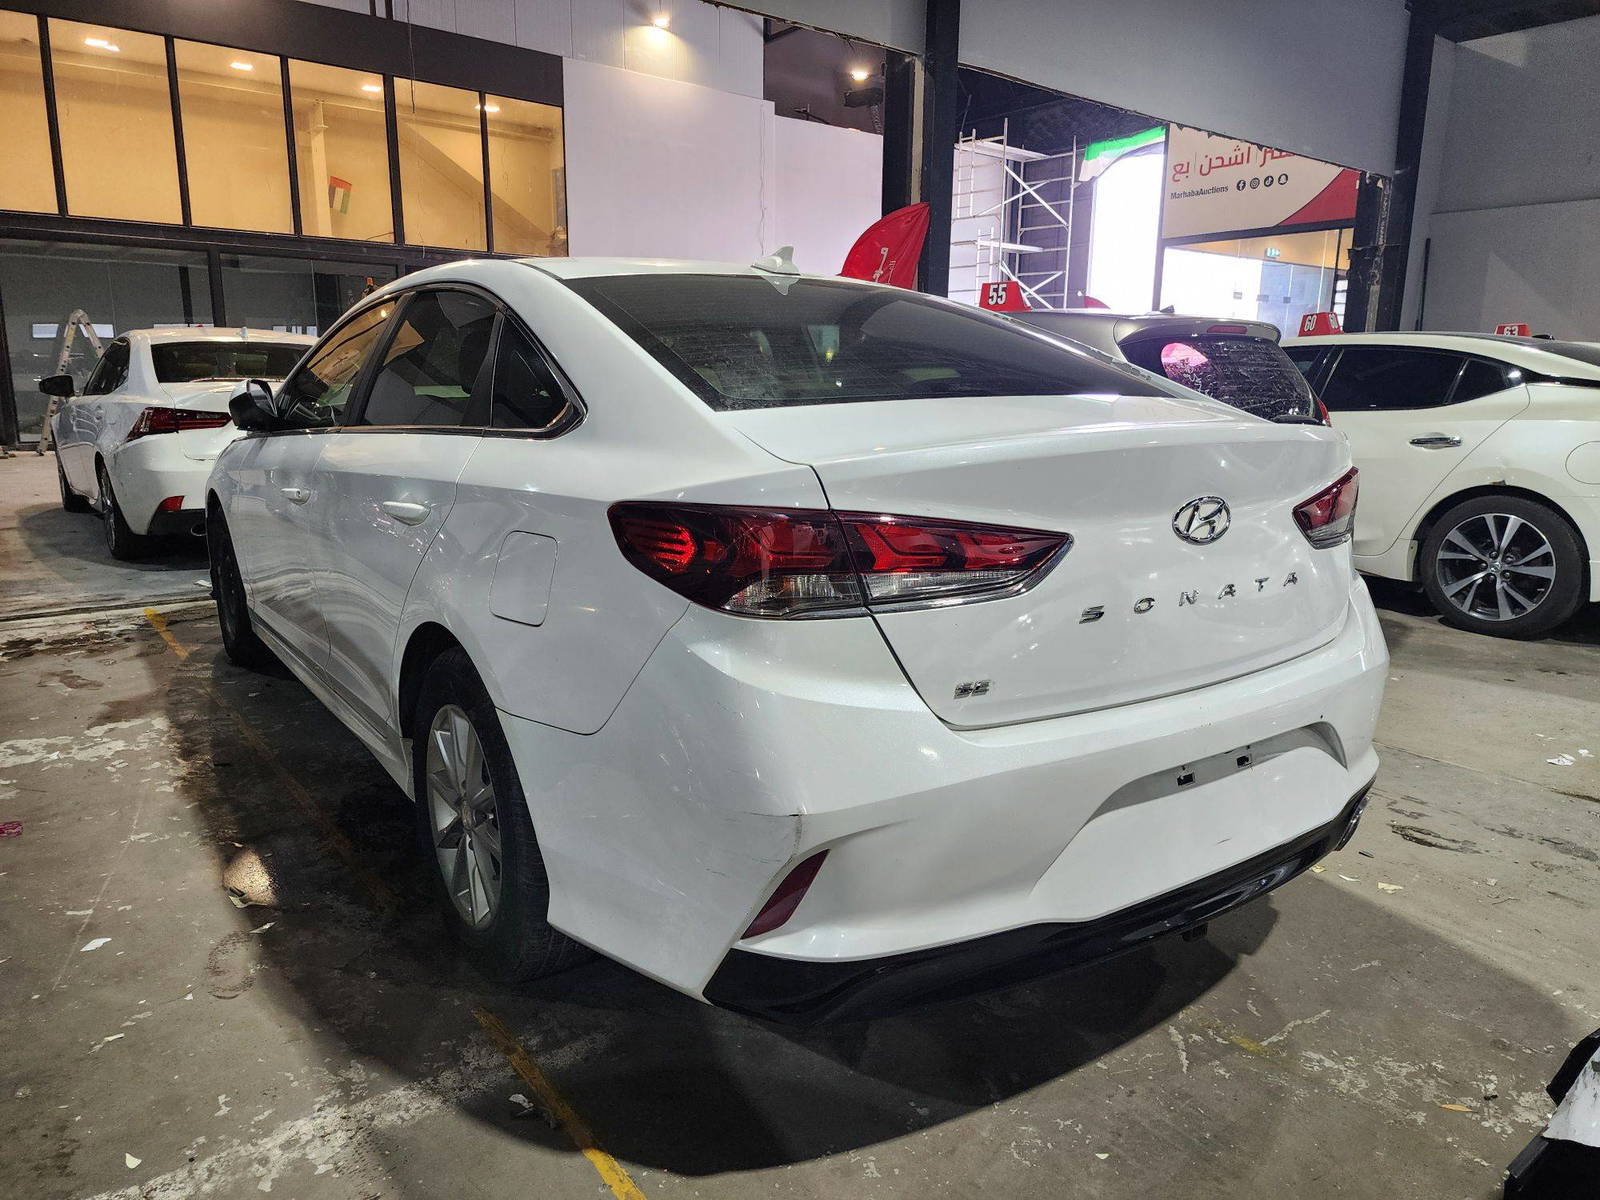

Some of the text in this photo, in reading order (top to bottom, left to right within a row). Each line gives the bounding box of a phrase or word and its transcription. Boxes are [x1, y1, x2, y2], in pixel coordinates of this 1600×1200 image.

[1199, 145, 1251, 176] اشحن
[1172, 162, 1190, 182] بع
[1170, 185, 1229, 200] MarhabaAuctions
[988, 283, 1008, 305] 55
[1303, 314, 1318, 332] 60
[1079, 571, 1299, 624] SONATA
[953, 680, 991, 700] SE
